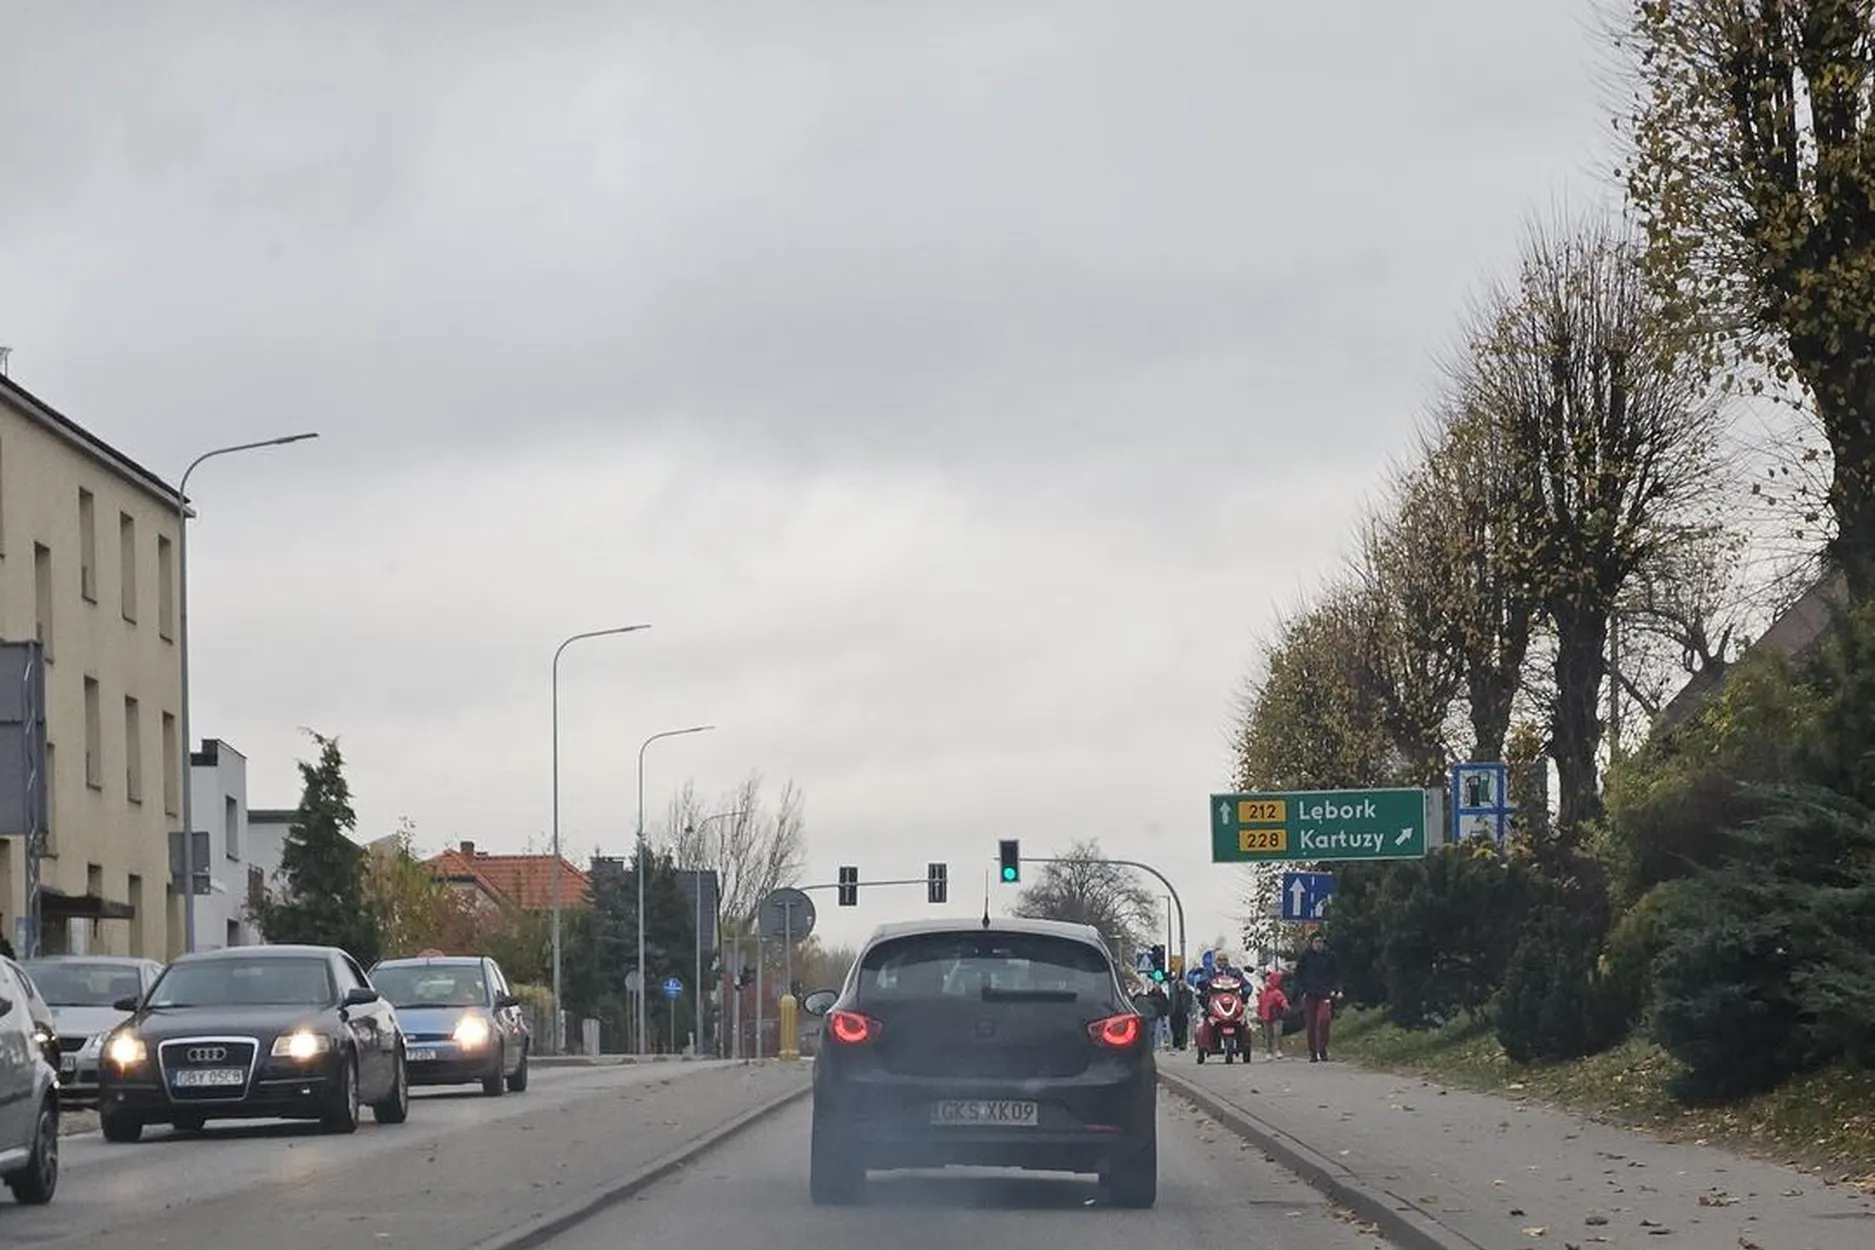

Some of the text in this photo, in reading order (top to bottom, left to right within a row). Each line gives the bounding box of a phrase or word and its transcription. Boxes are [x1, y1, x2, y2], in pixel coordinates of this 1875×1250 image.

[1248, 799, 1376, 824] 212 Lębork
[1246, 829, 1384, 852] 228 Kartuzy
[941, 1102, 1034, 1120] GKS XK09
